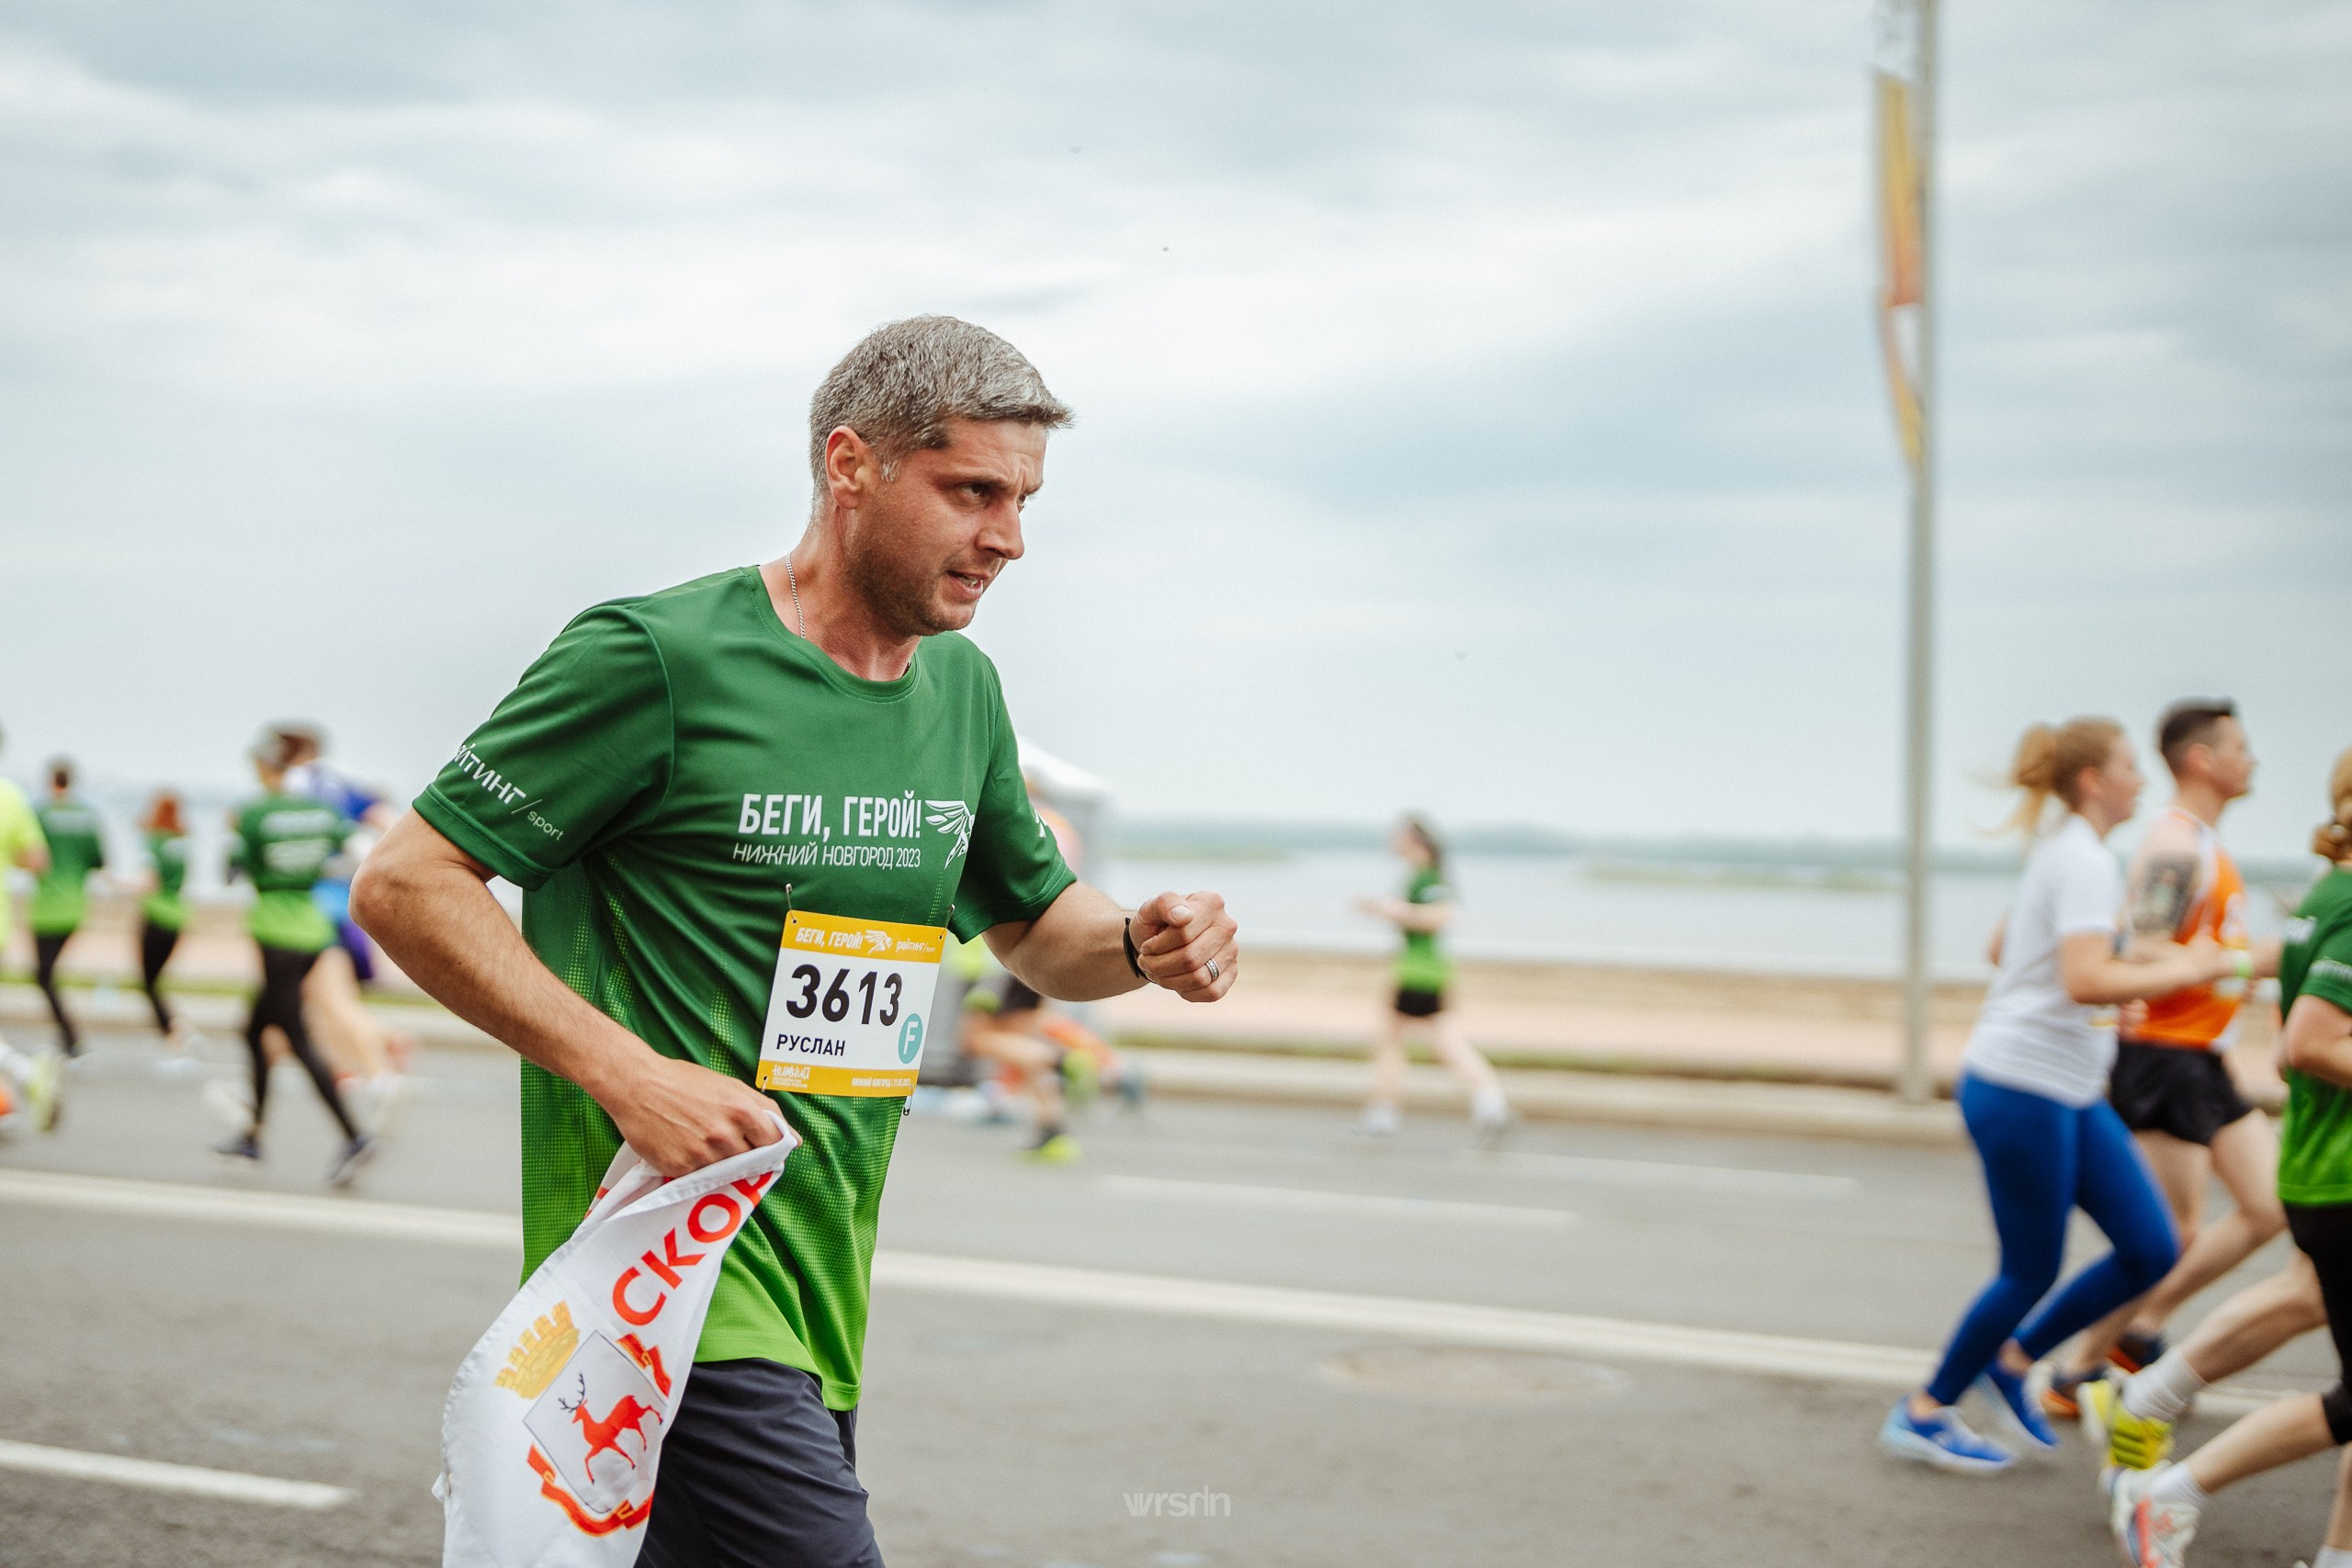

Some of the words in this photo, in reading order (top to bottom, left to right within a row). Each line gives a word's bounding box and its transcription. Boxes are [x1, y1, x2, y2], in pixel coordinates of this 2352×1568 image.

[527, 810, 564, 841] sport
[738, 793, 831, 842] БЕГИ,
[843, 790, 922, 838] ГЕРОЙ!
[733, 840, 818, 866] НИЖНИЙ
[821, 845, 893, 870] НОВГОРОД
[896, 847, 921, 868] 2023
[796, 927, 825, 947] БЕГИ,
[828, 931, 864, 950] ГЕРОЙ!
[786, 964, 903, 1027] 3613
[776, 1033, 845, 1056] РУСЛАН
[902, 1021, 919, 1055] F
